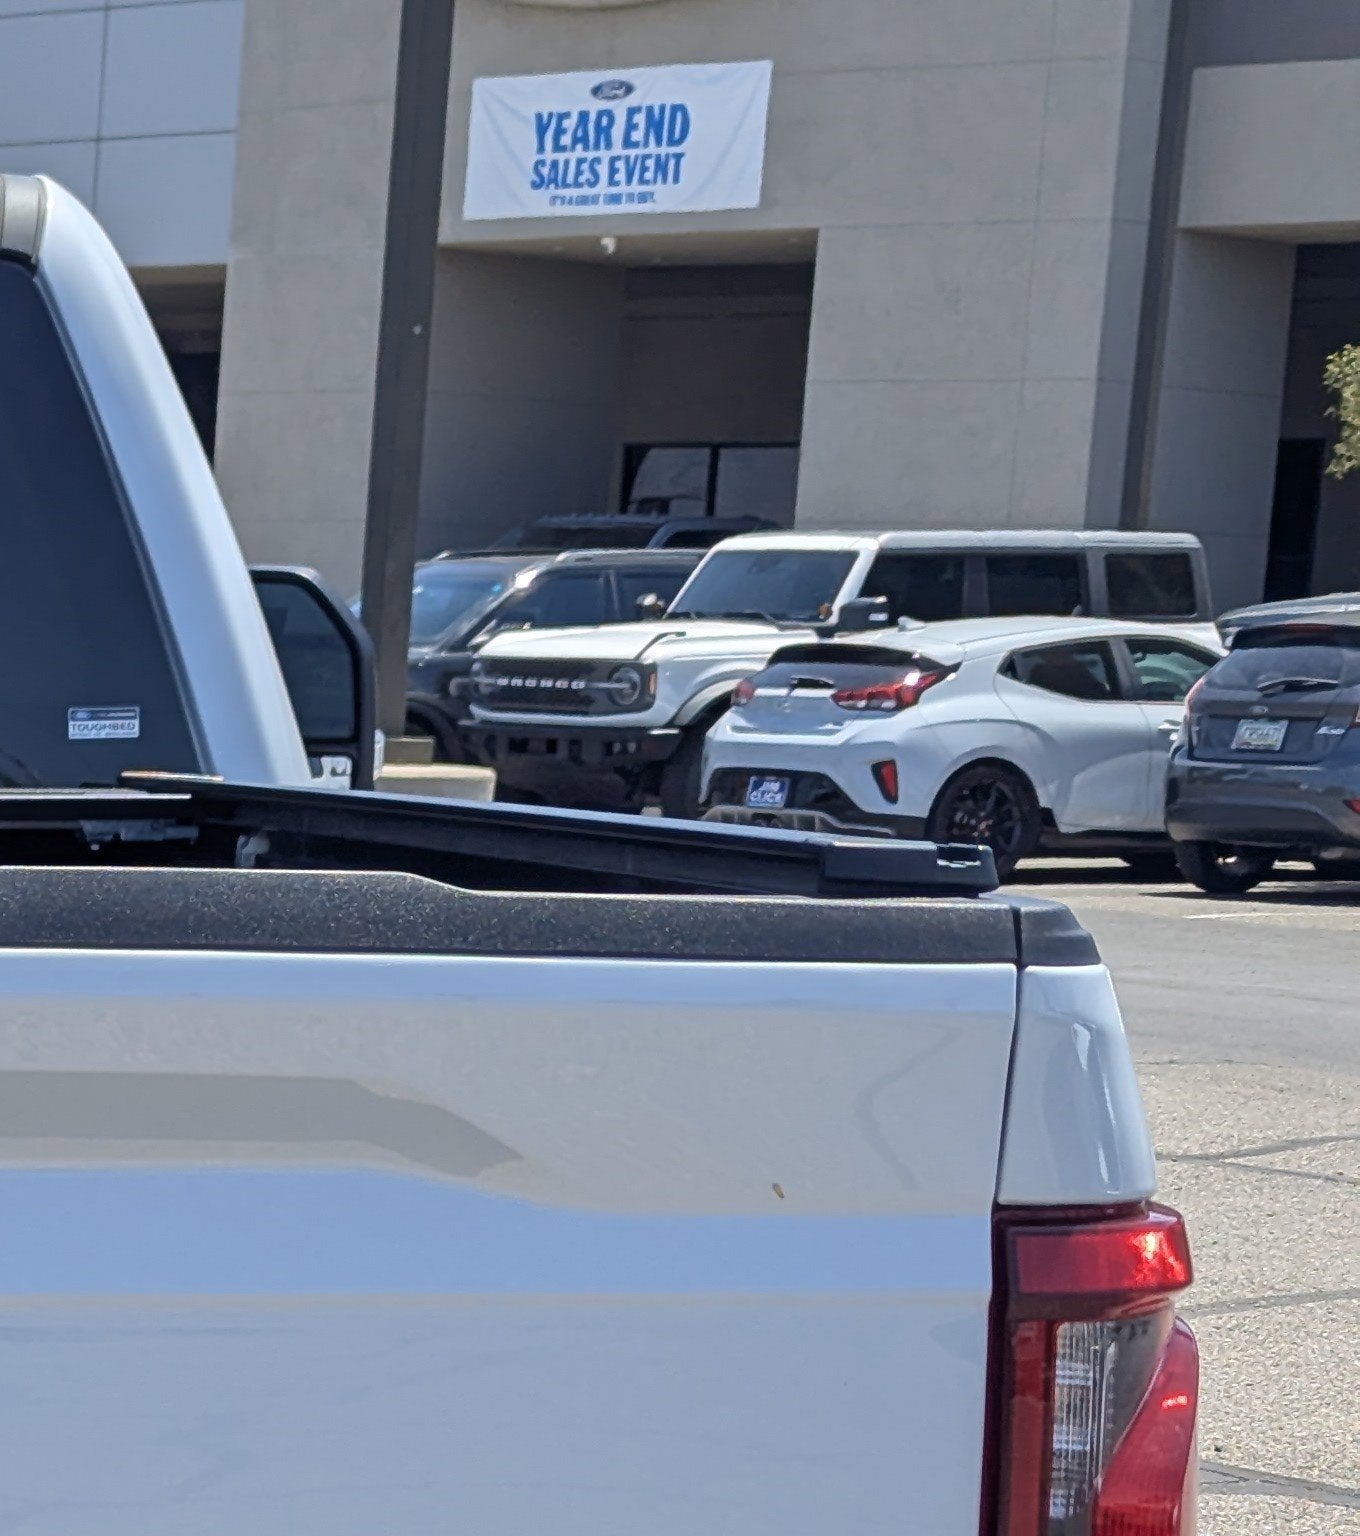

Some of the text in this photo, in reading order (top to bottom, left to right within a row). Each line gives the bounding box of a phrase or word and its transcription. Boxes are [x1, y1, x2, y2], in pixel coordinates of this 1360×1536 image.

[534, 104, 690, 153] YEAR END
[531, 152, 685, 190] SALES EVENT
